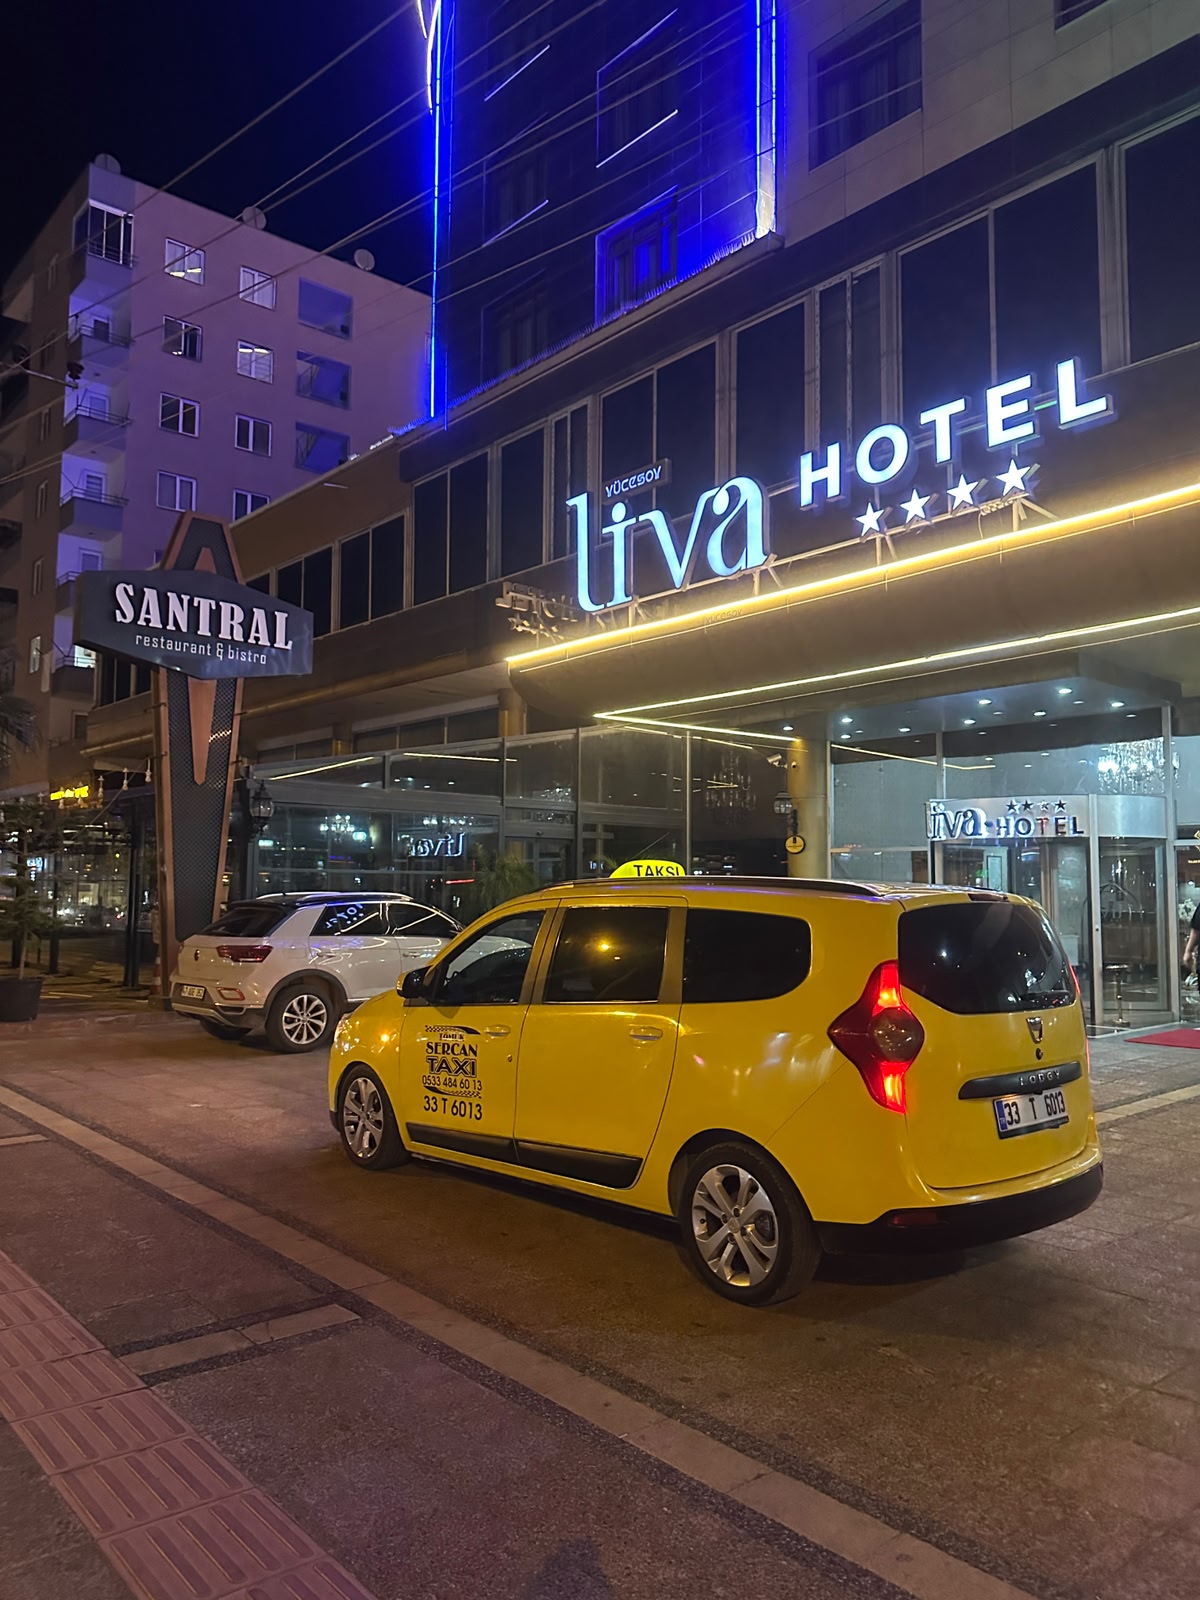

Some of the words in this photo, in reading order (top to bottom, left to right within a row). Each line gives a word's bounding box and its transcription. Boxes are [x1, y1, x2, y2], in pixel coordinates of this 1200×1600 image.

[565, 475, 770, 613] liva
[800, 357, 1110, 508] HOTEL
[114, 582, 293, 650] SANTRAL
[135, 634, 212, 656] restaurant
[216, 643, 225, 661] &
[227, 644, 267, 664] bistro
[996, 815, 1084, 839] HOTEL
[425, 1041, 478, 1058] SERCAN
[425, 1056, 478, 1078] TAXI
[422, 1074, 441, 1087] 0533
[443, 1077, 458, 1089] 484
[460, 1078, 470, 1090] 60
[473, 1080, 483, 1091] 13
[423, 1095, 438, 1112] 33
[441, 1097, 448, 1114] T
[451, 1099, 483, 1121] 6013
[1004, 1101, 1021, 1126] 33
[1028, 1097, 1037, 1120] T
[1044, 1090, 1066, 1117] 6013
